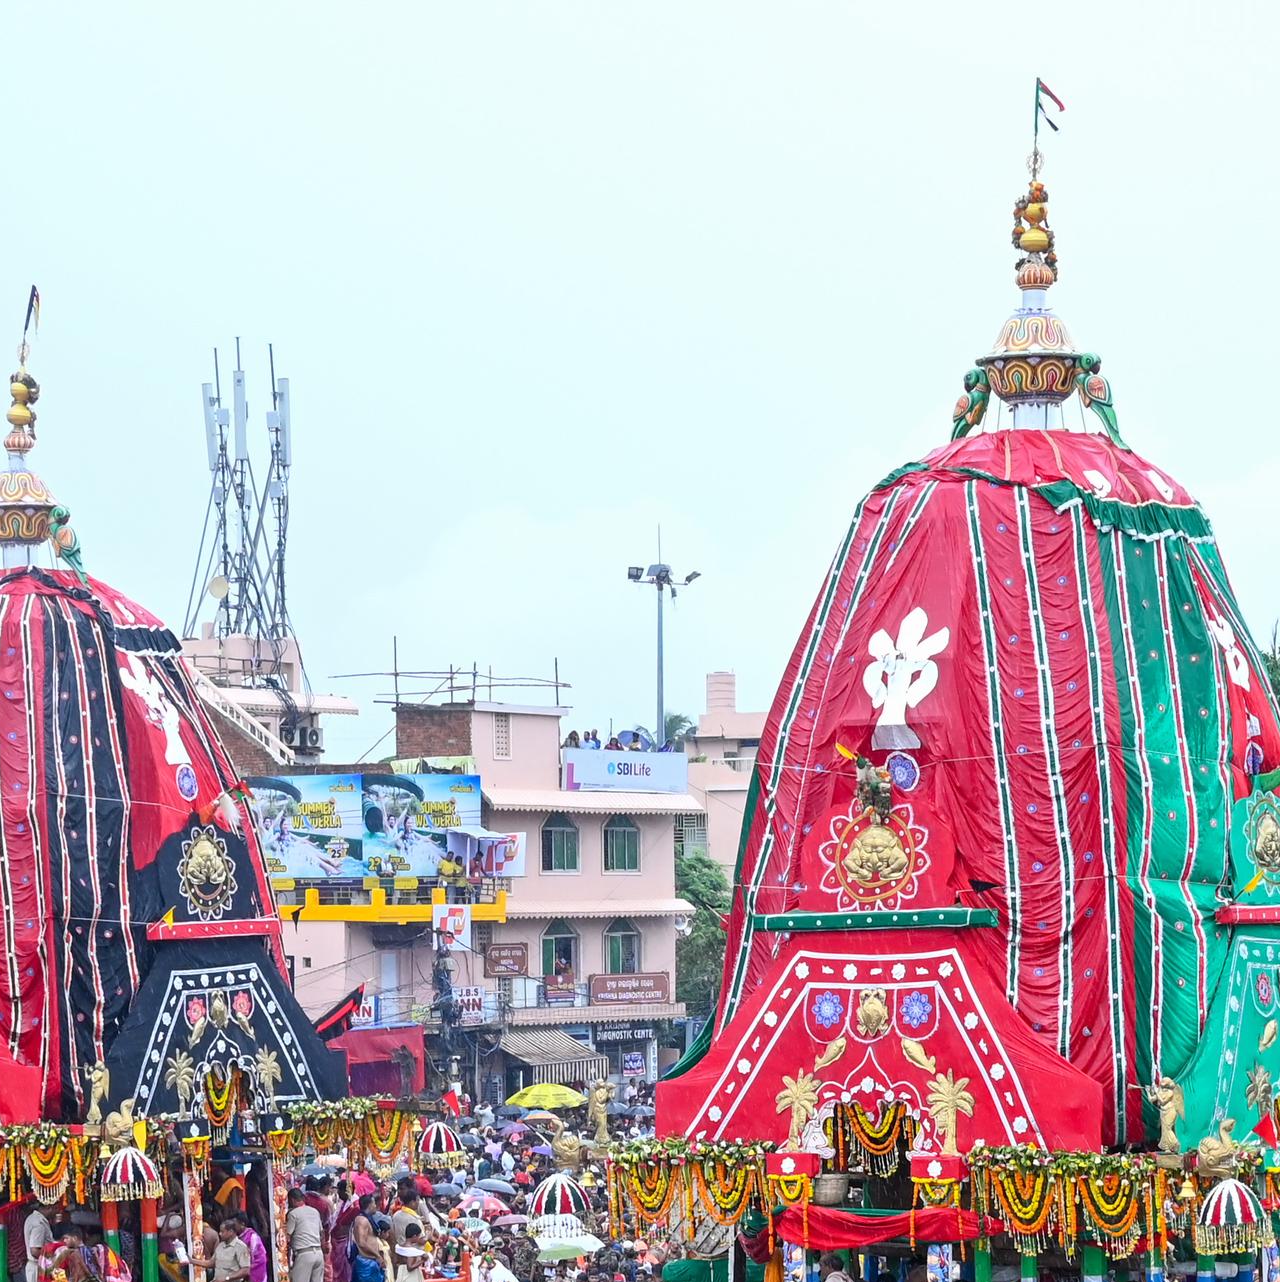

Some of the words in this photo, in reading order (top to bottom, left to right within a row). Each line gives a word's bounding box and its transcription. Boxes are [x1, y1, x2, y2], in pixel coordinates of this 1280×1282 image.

[616, 762, 632, 776] SBI
[633, 763, 651, 776] Life
[297, 801, 336, 815] SUMMER
[420, 801, 456, 815] SUMMER
[330, 849, 342, 859] 25
[459, 997, 482, 1011] NN
[596, 1029, 632, 1041] DIAGNOSTIC
